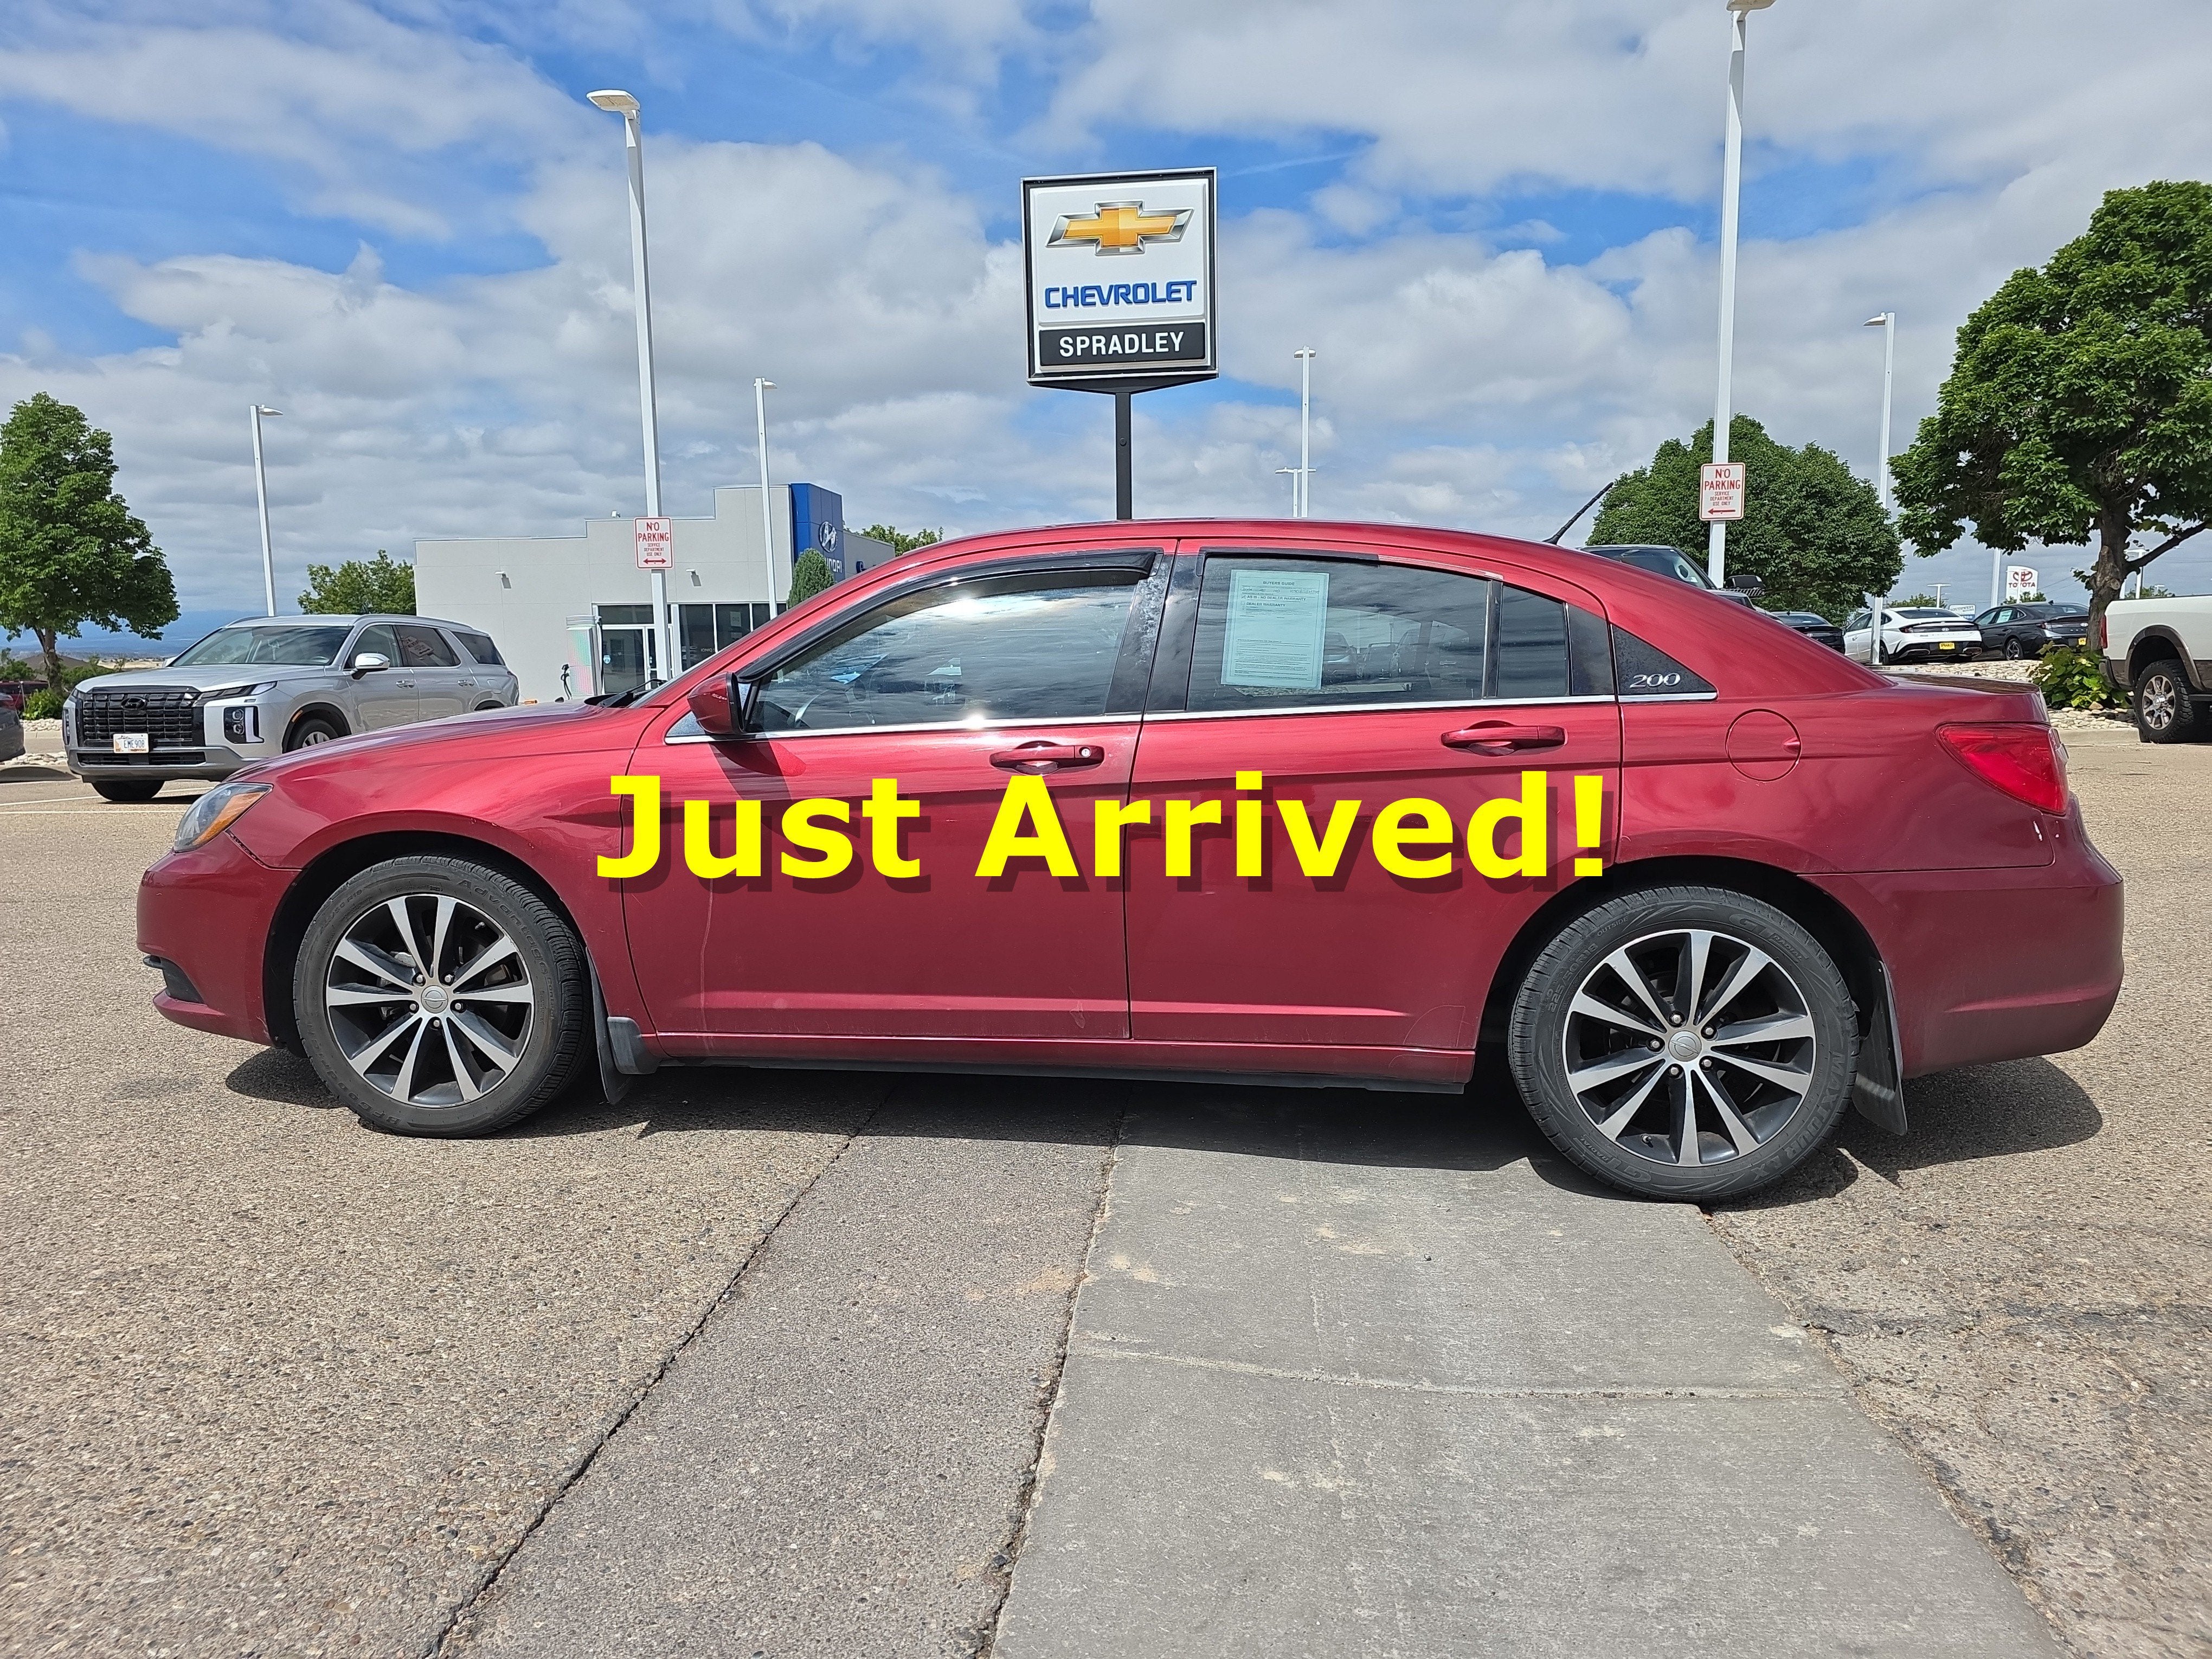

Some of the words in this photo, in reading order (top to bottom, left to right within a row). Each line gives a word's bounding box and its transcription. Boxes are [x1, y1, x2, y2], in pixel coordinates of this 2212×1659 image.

[1045, 280, 1197, 308] CHEVROLET
[1059, 331, 1185, 357] SPRADLEY
[1715, 468, 1731, 478] NO
[1705, 480, 1741, 490] PARKING
[646, 522, 660, 531] NO
[638, 532, 669, 542] PARKING
[1630, 673, 1681, 689] 200
[1597, 916, 1629, 936] OUTSIDE
[1548, 943, 1598, 1013] 225/50R18
[307, 1023, 401, 1131] BFGoodrich
